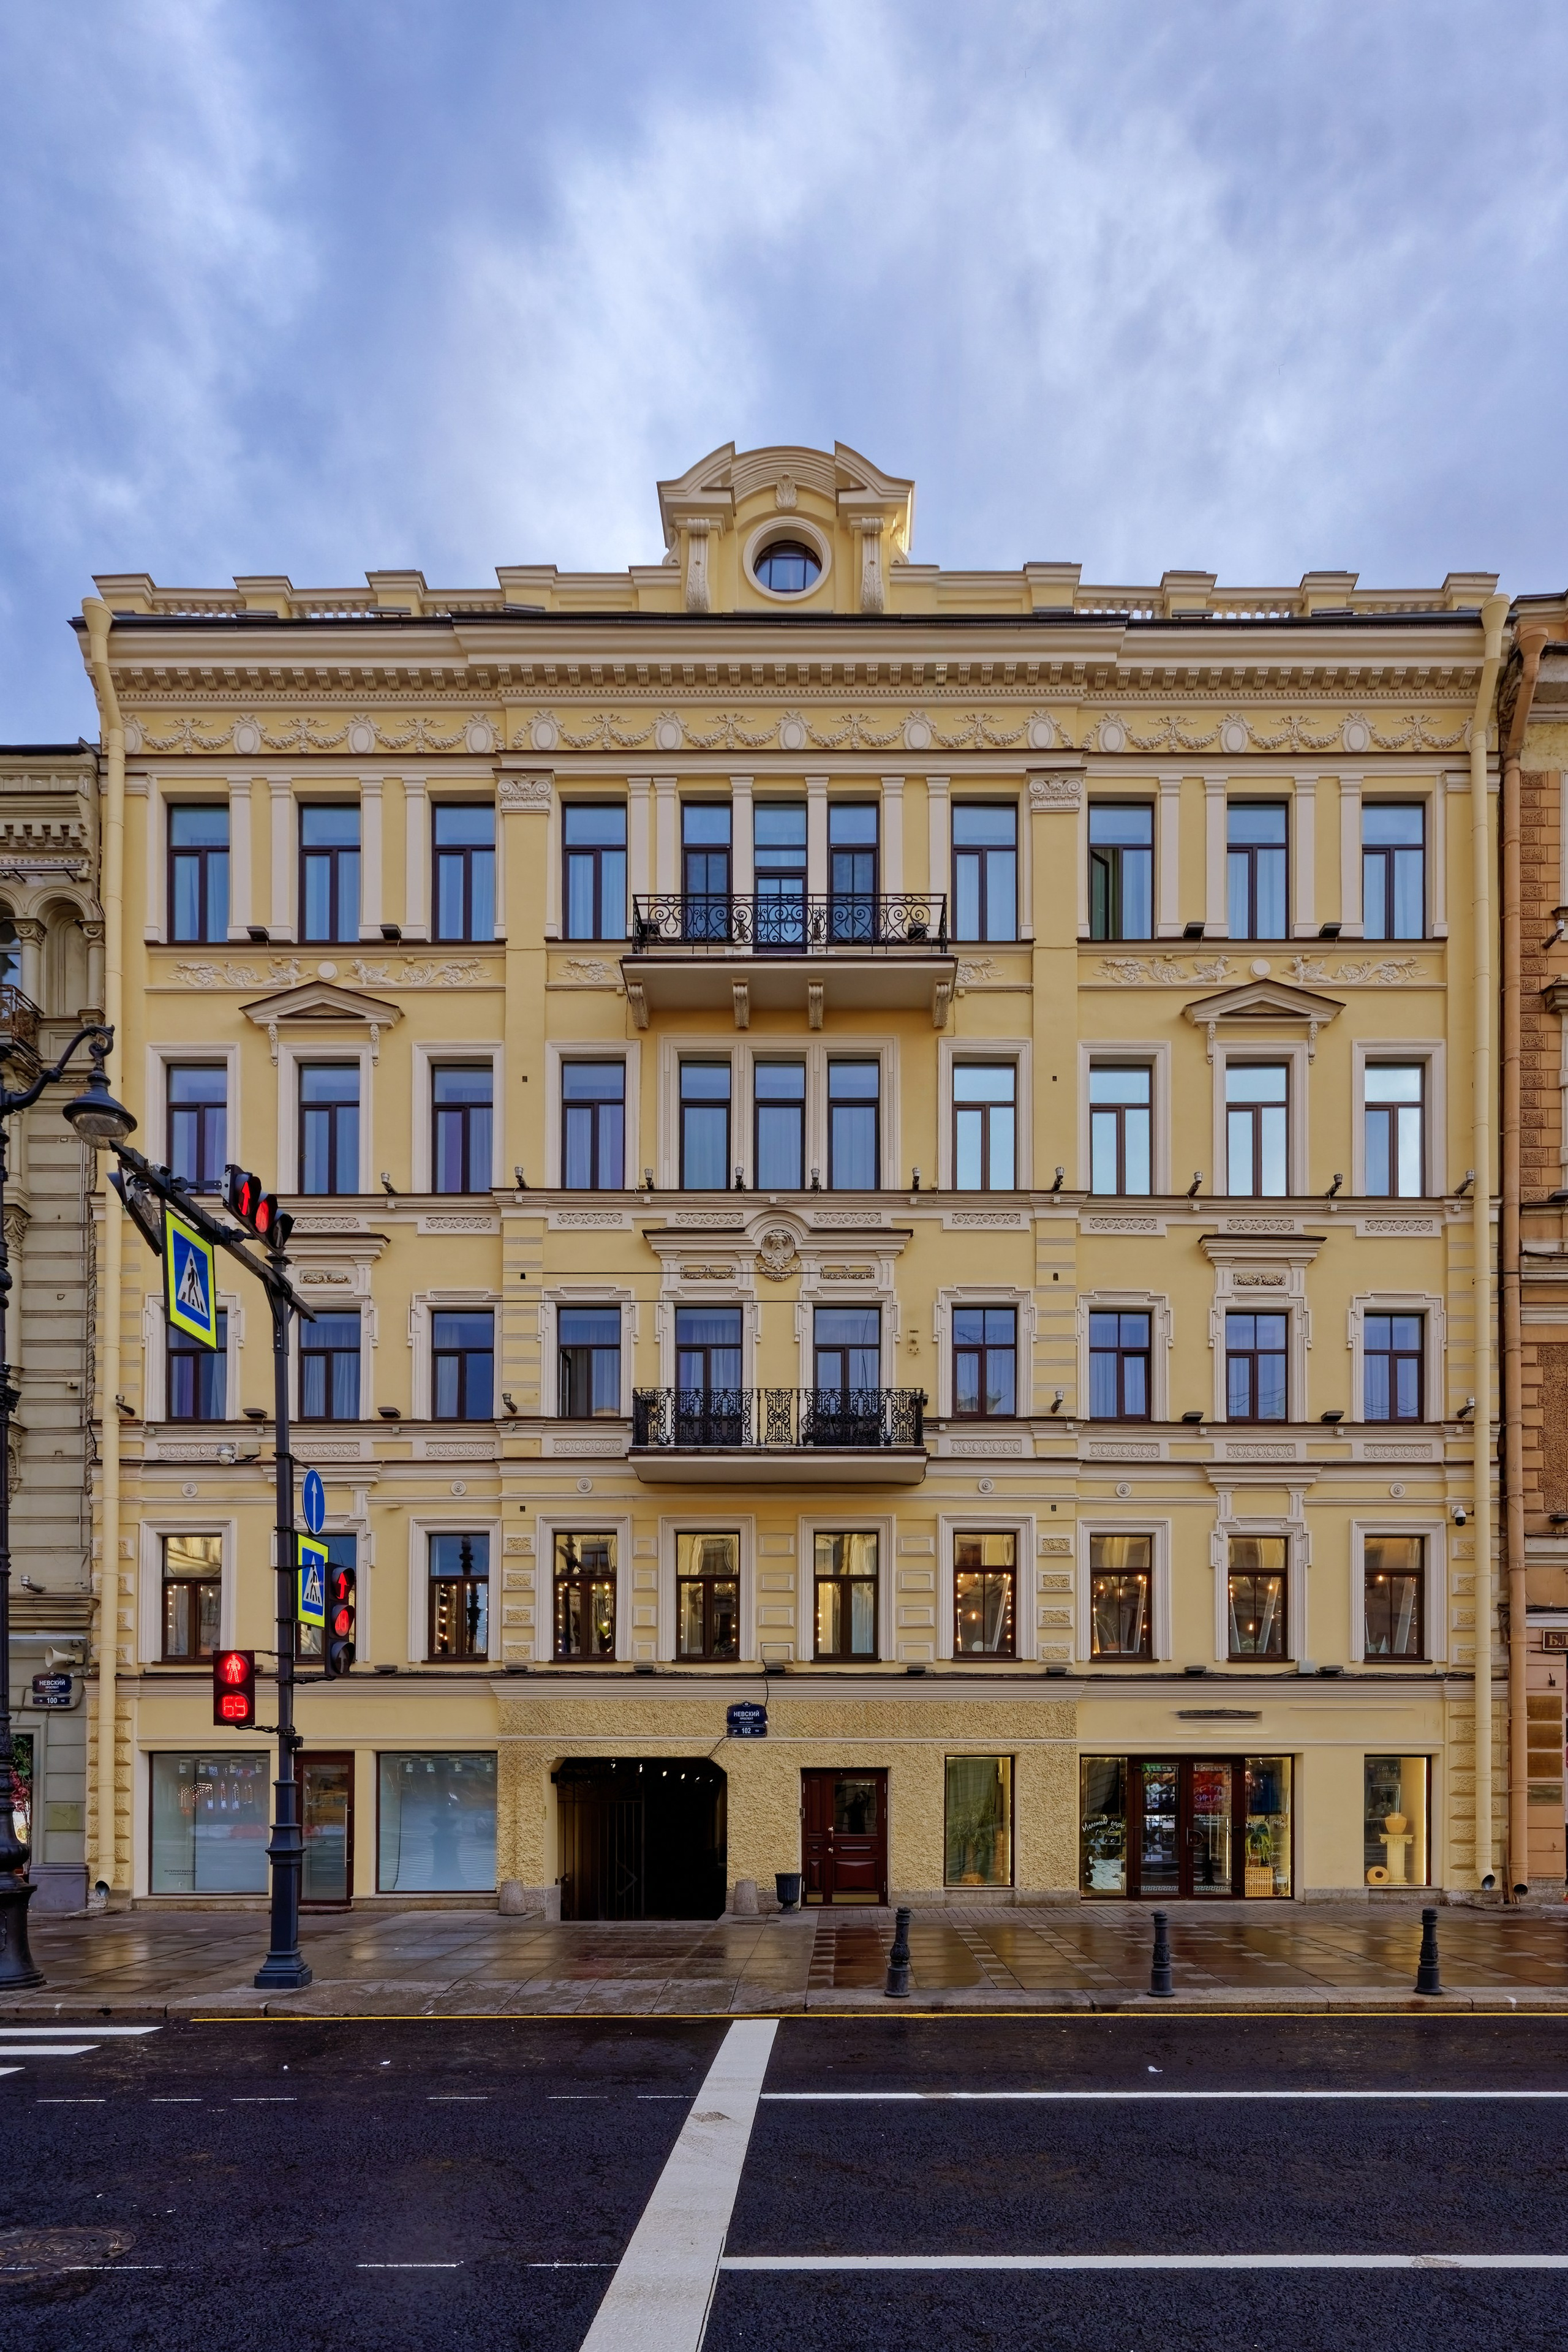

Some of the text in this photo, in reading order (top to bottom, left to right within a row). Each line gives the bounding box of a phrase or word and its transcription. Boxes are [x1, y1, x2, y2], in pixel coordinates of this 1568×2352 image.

[222, 1696, 246, 1716] 69
[1082, 1818, 1126, 1833] Молотый кофе
